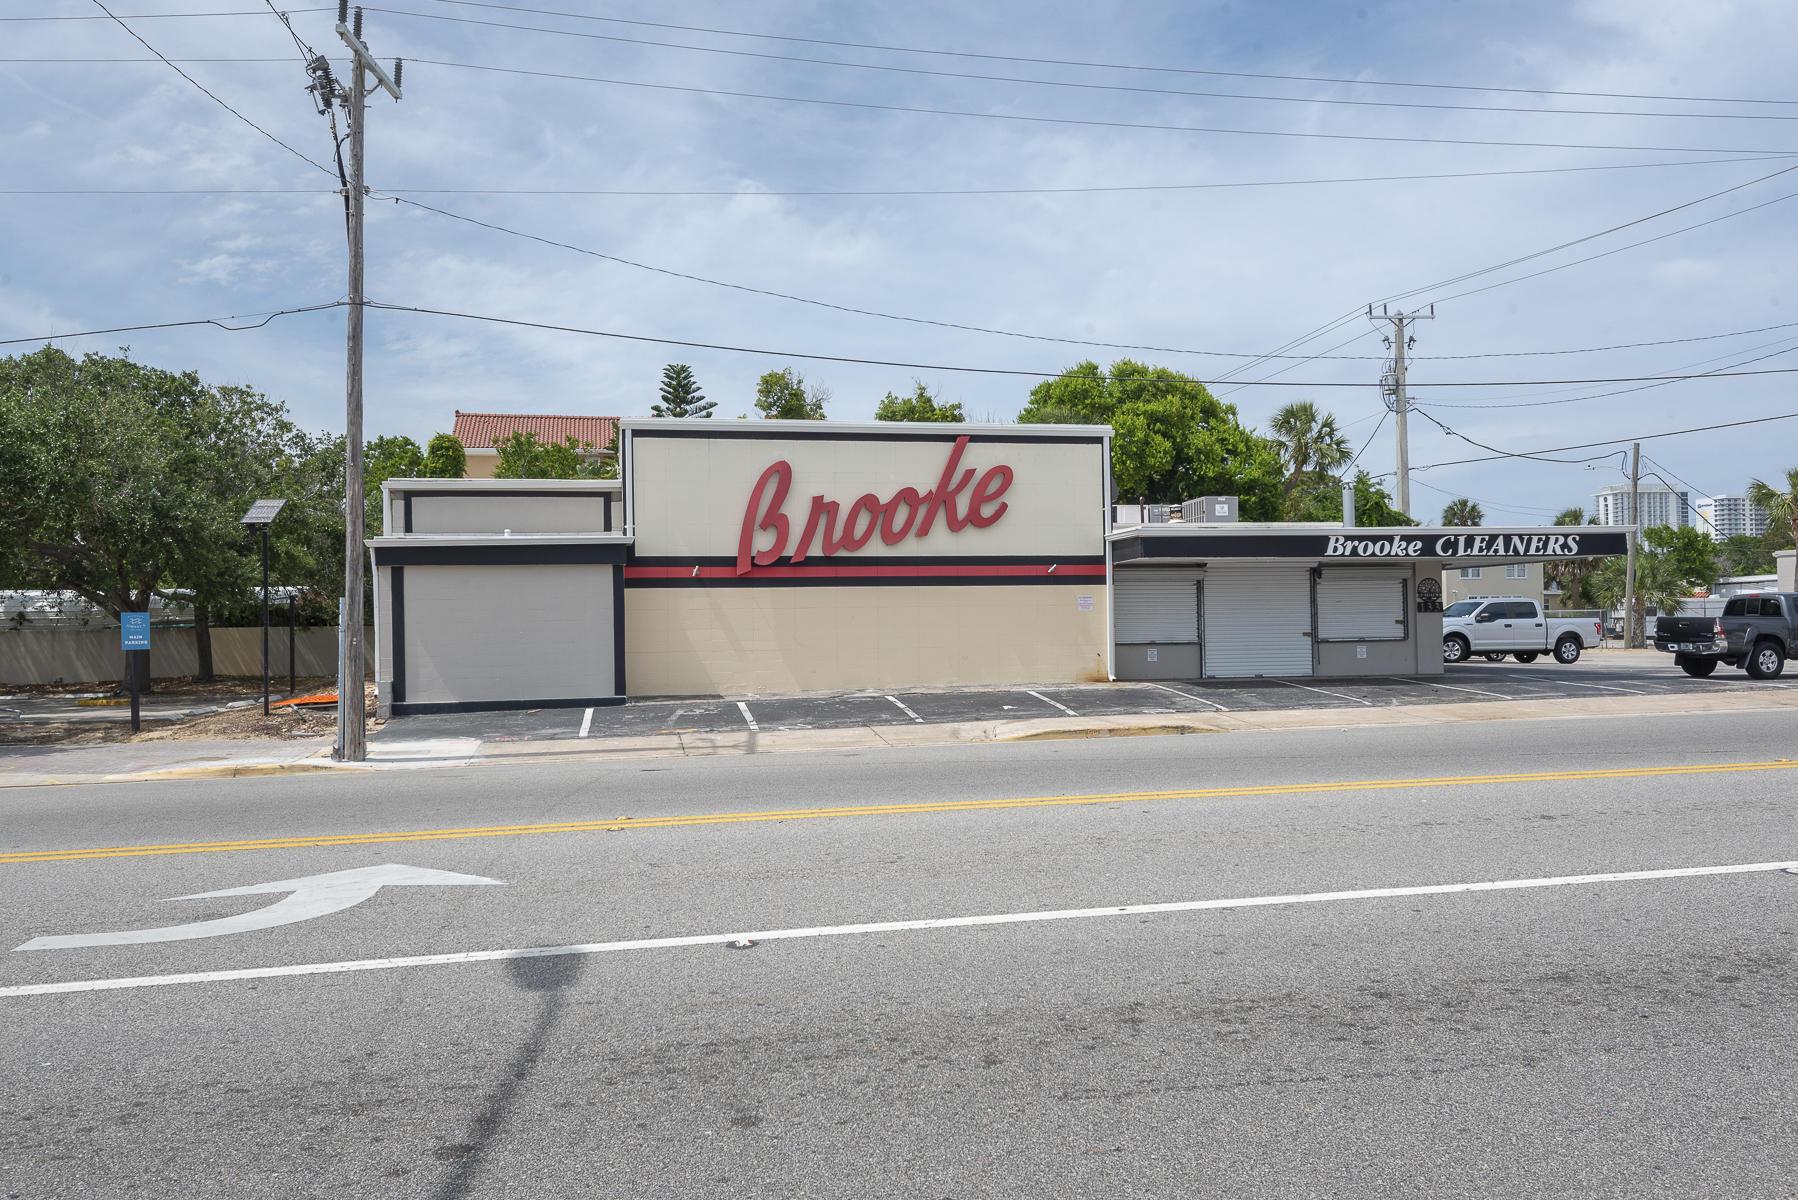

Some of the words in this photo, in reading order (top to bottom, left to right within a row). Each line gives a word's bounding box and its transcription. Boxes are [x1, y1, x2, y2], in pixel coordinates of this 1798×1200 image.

[736, 435, 1014, 576] Brooke
[1324, 535, 1423, 557] Brooke
[1435, 535, 1580, 557] CLEANERS
